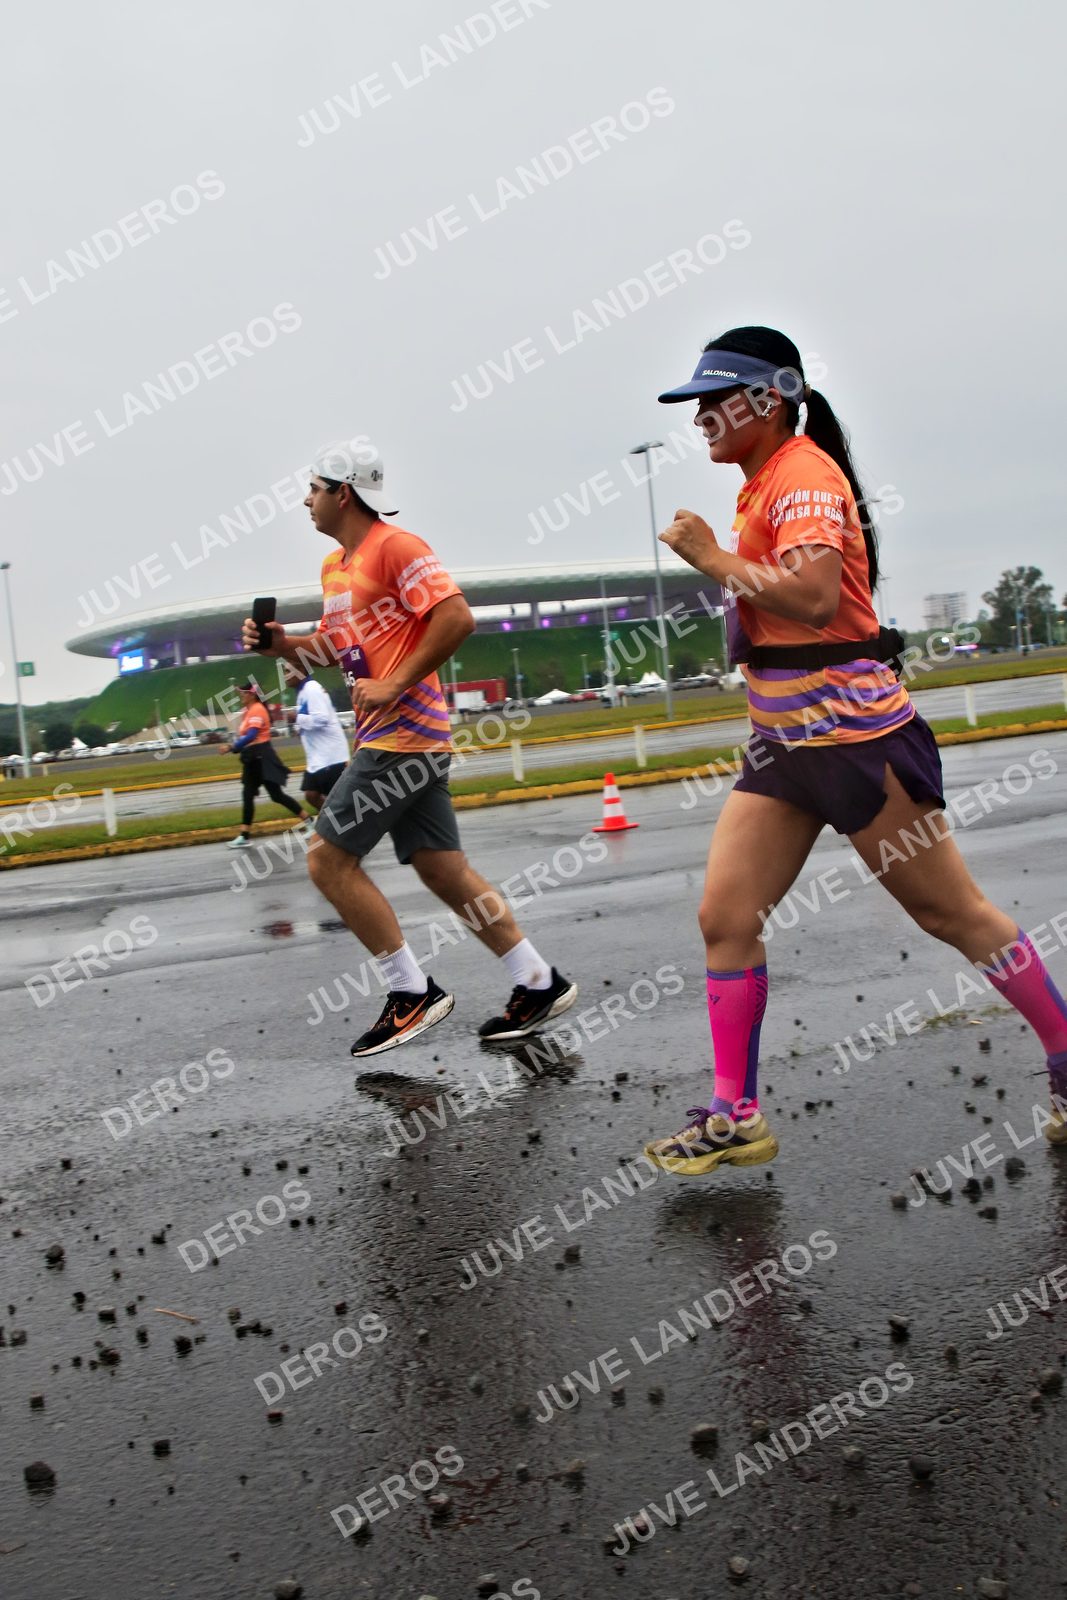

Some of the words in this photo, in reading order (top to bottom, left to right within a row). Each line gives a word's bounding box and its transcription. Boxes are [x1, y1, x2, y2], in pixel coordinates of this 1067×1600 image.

[702, 369, 738, 379] SALOMON
[813, 490, 833, 504] QUE
[814, 505, 821, 517] A
